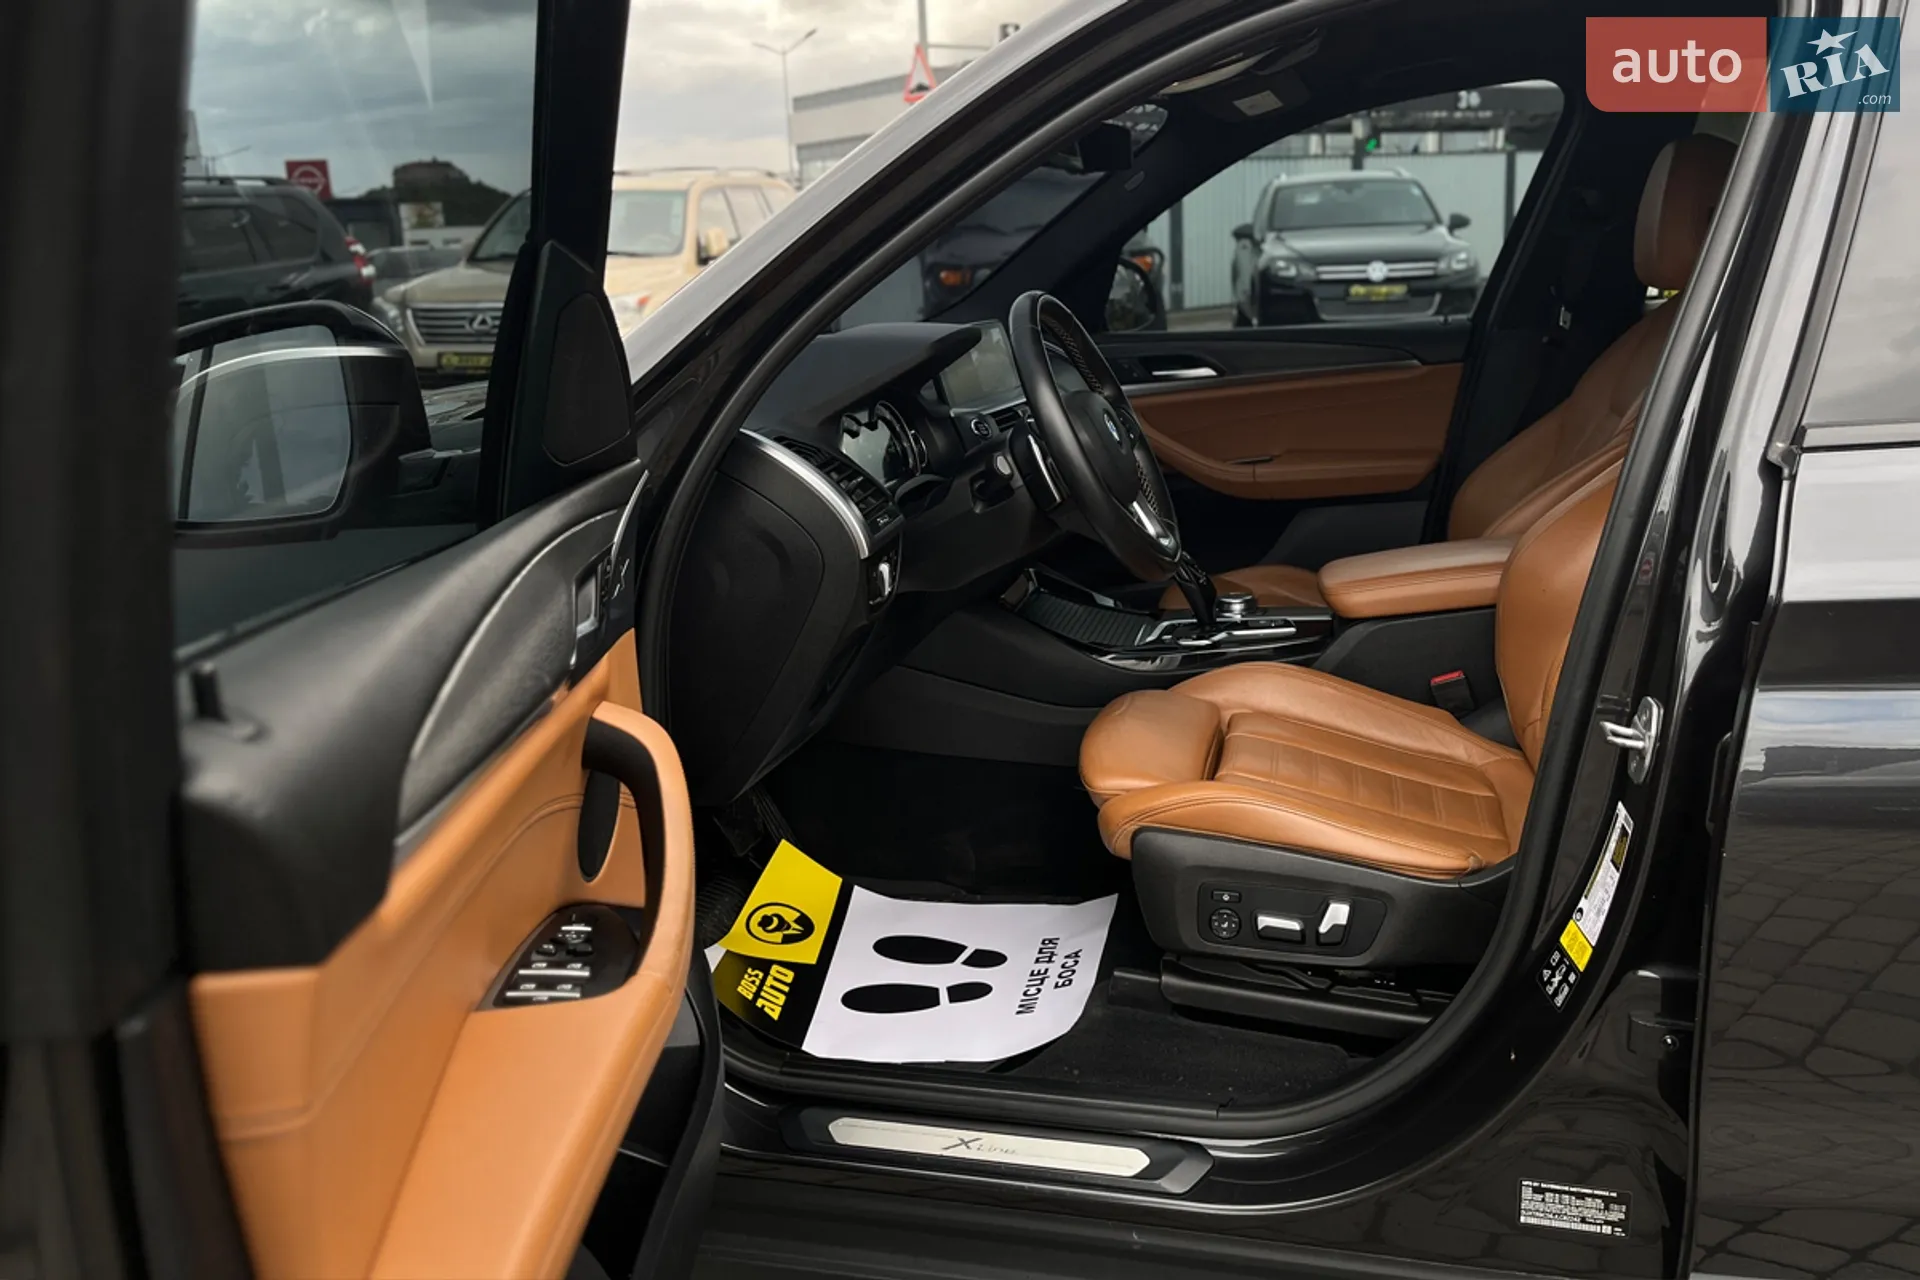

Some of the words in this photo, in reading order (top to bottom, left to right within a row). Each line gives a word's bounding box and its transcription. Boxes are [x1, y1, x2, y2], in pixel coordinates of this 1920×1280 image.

[736, 967, 764, 1001] BOSS
[1015, 967, 1050, 1015] МІСЦЕ
[1034, 937, 1060, 964] ДЛЯ
[1053, 948, 1083, 989] БОСА
